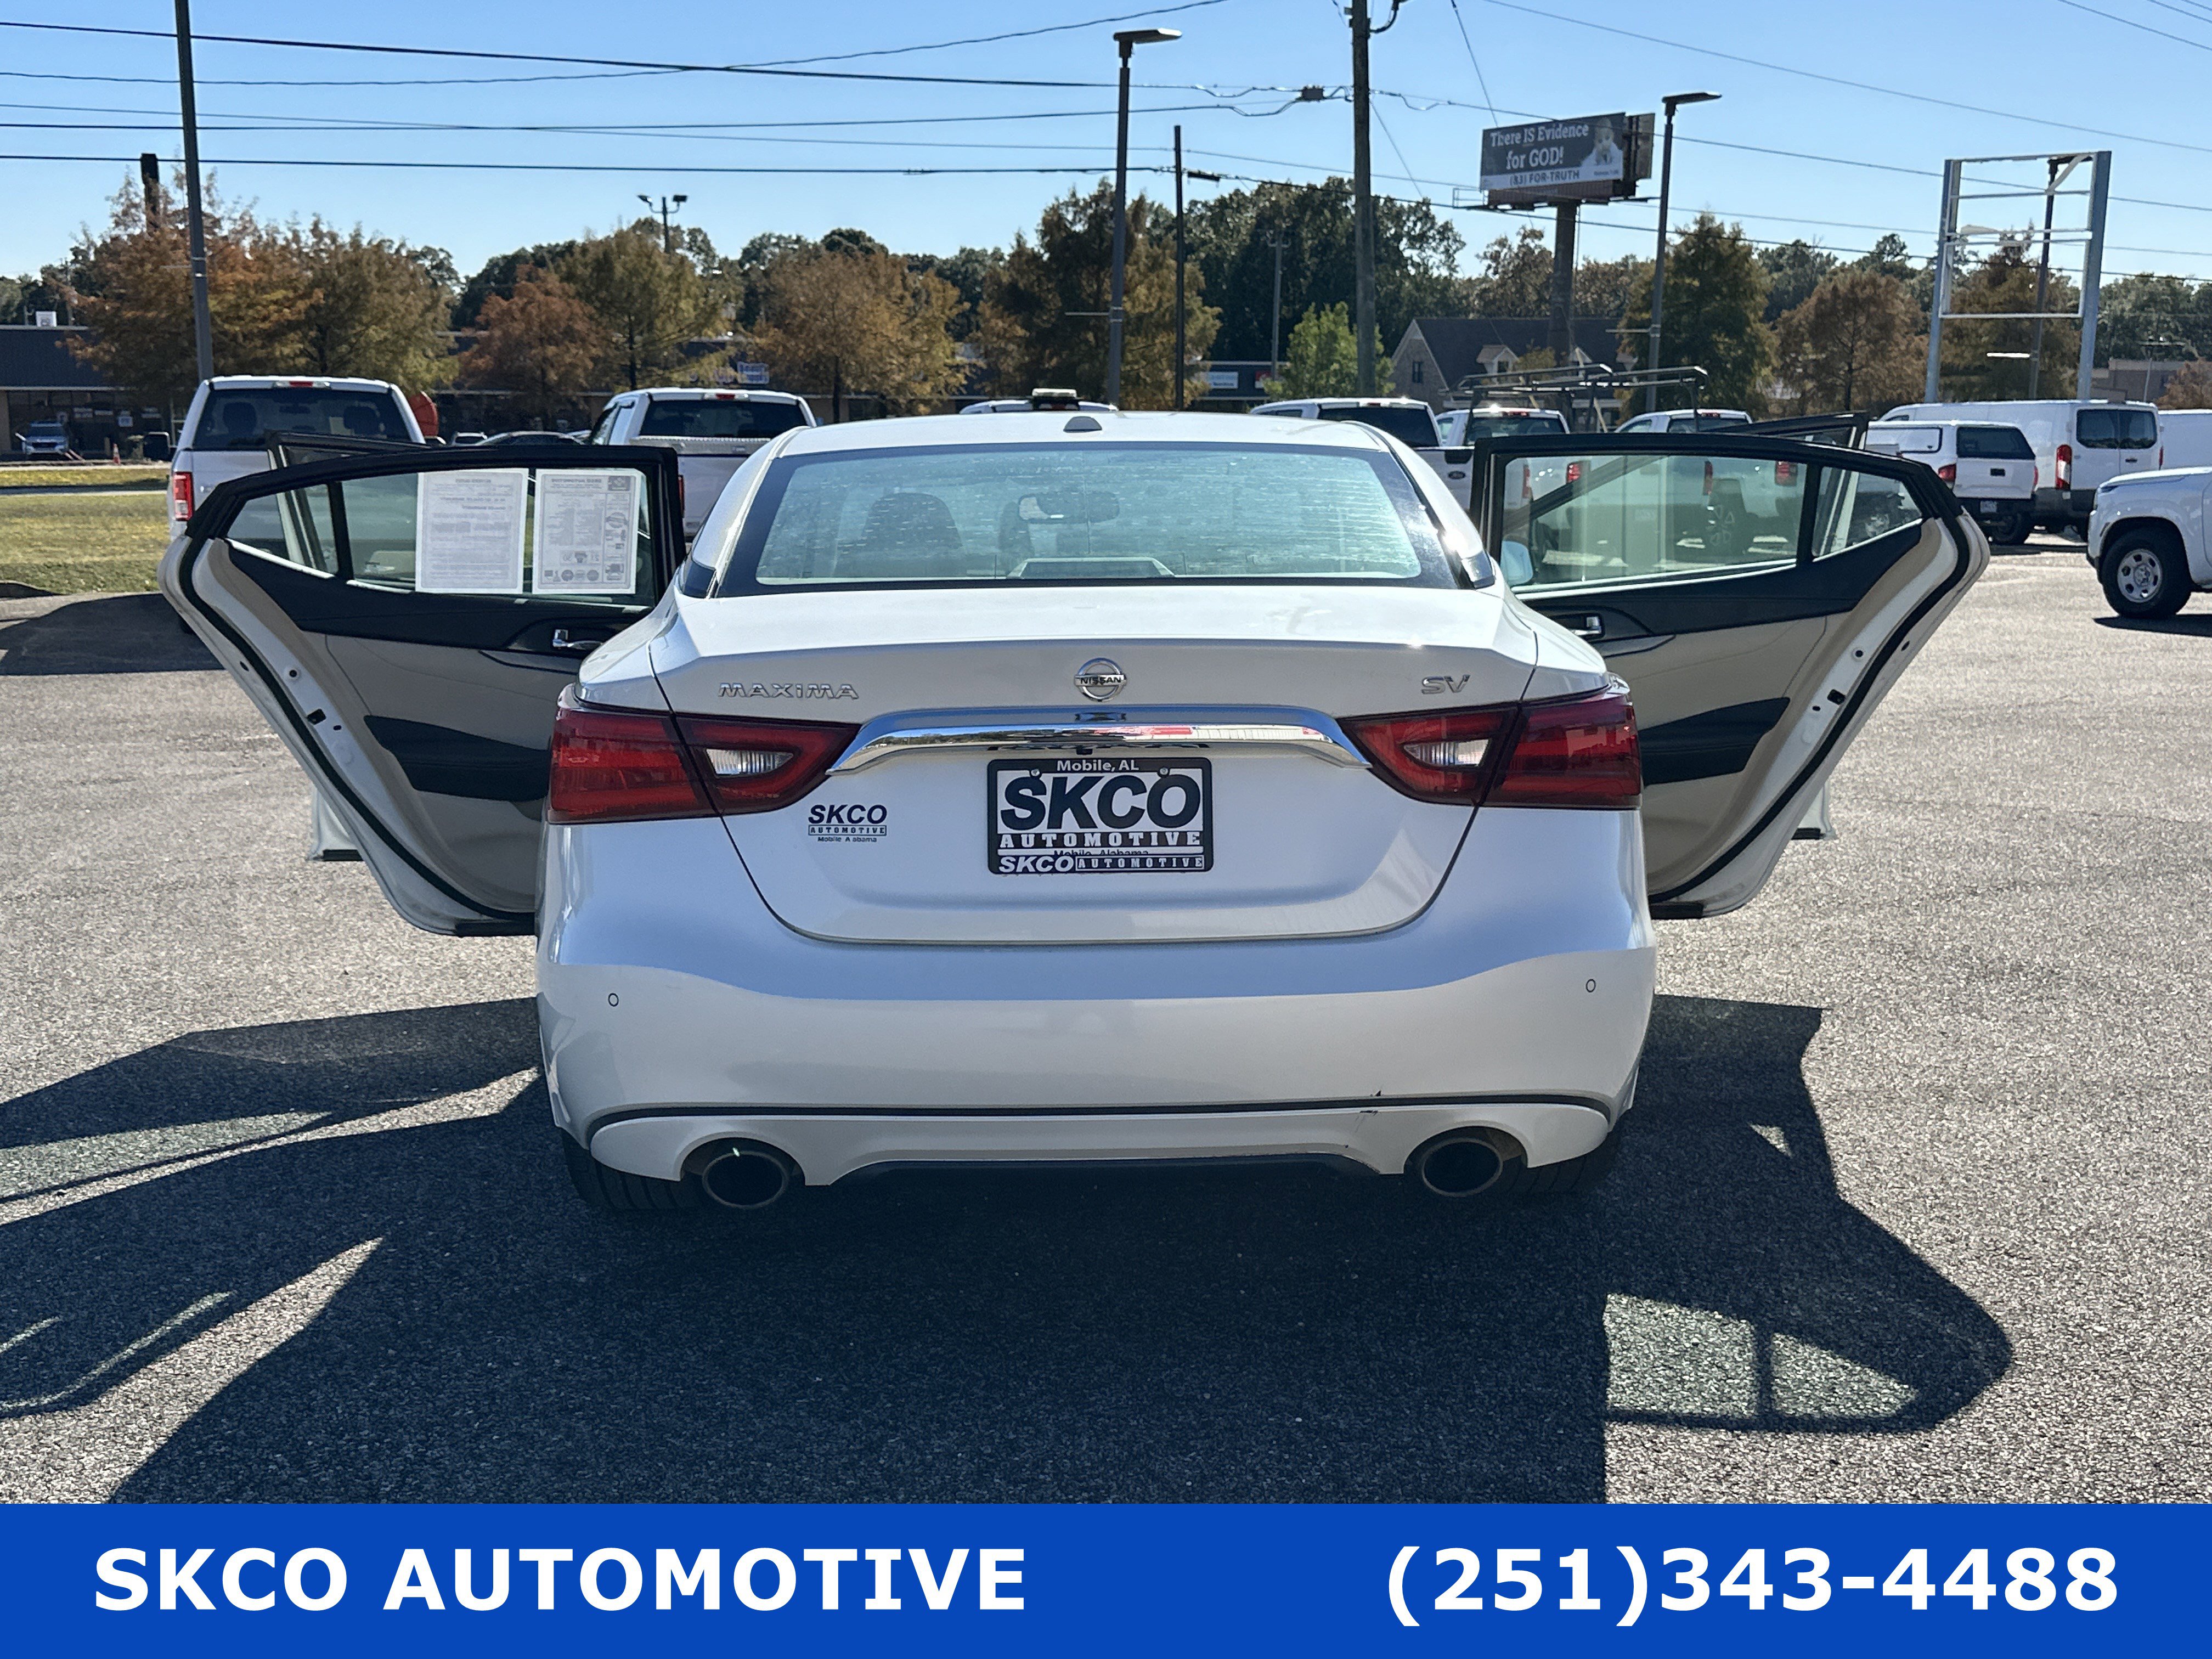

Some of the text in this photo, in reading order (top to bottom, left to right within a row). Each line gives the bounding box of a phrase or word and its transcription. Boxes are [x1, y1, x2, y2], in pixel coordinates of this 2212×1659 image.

[1489, 123, 1589, 147] There IS Evidence
[1506, 146, 1564, 170] for GOD!
[1080, 676, 1121, 685] NISSAN
[1421, 674, 1471, 695] SV
[718, 682, 860, 699] MAXIMA
[1057, 759, 1139, 772] Mobile, AL
[1000, 774, 1201, 831] SKCO
[808, 804, 887, 824] SKCO
[1000, 831, 1200, 848] AUTOMOTIVE
[998, 856, 1203, 873] SKCO AUTOMOTIVE
